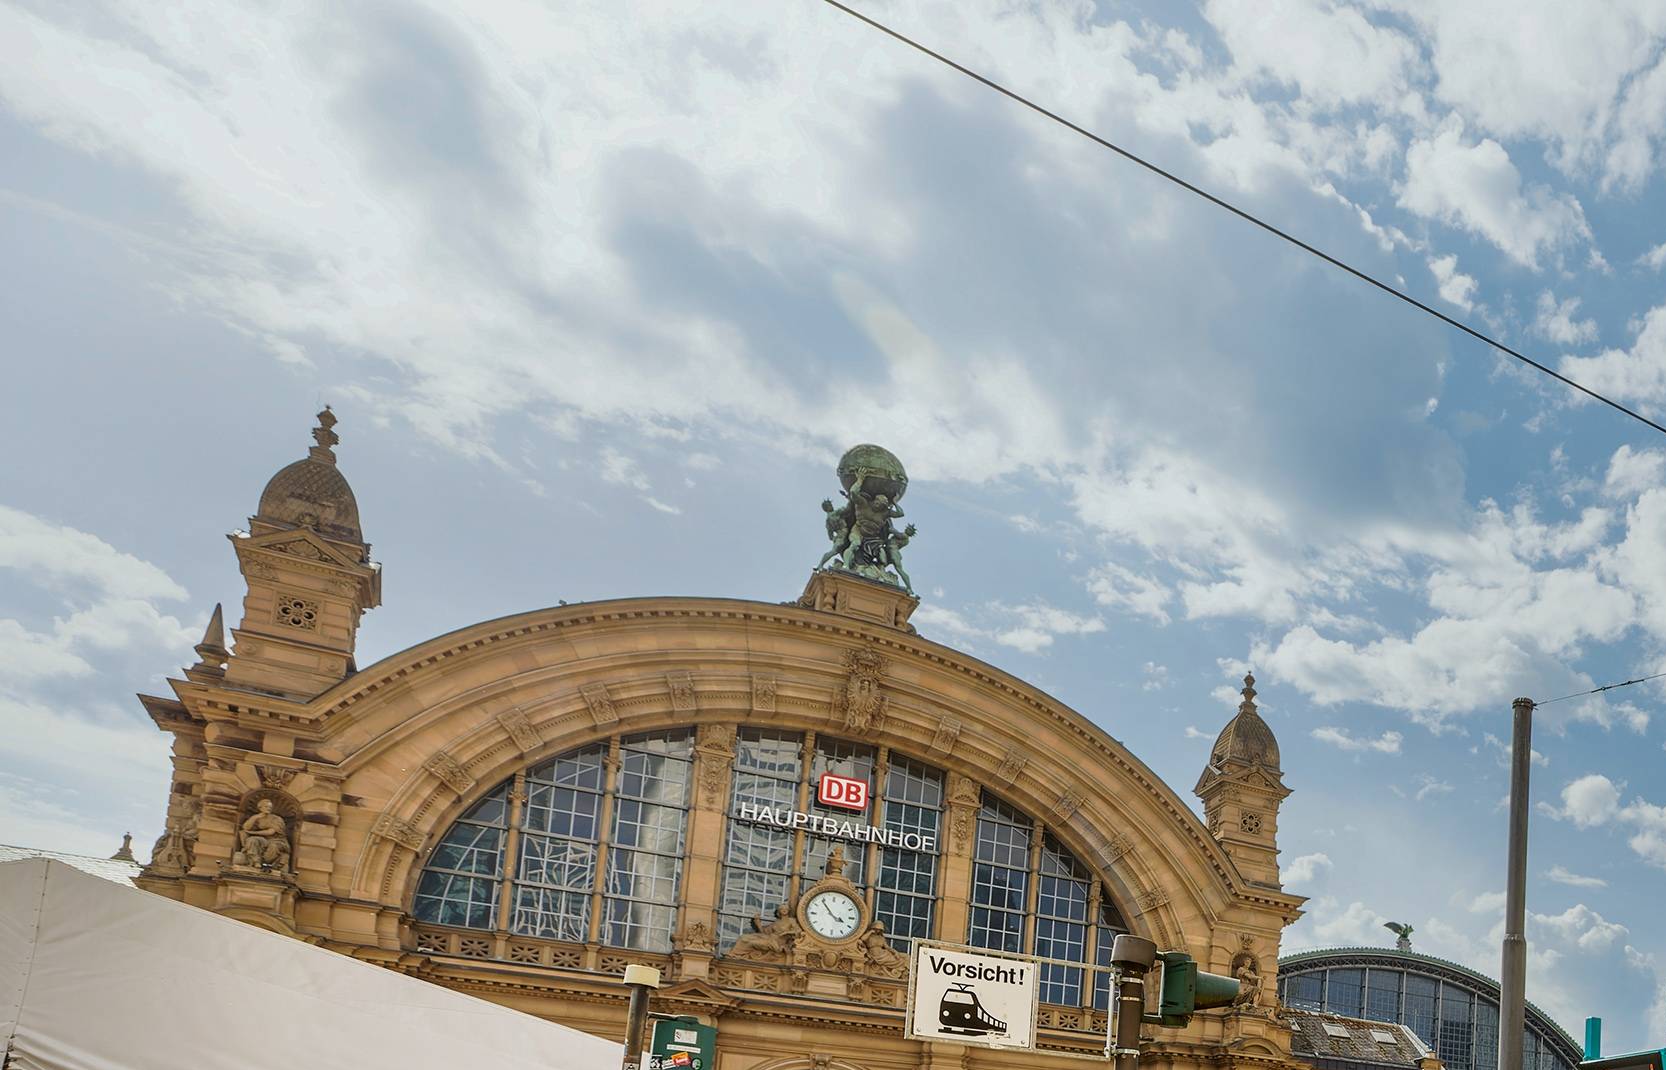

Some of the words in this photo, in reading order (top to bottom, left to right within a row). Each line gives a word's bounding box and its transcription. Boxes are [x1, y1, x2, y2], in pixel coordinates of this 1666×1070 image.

[826, 779, 862, 803] DB
[740, 802, 935, 852] HAUPTBAHNHOF
[929, 955, 1024, 985] Vorsicht!
